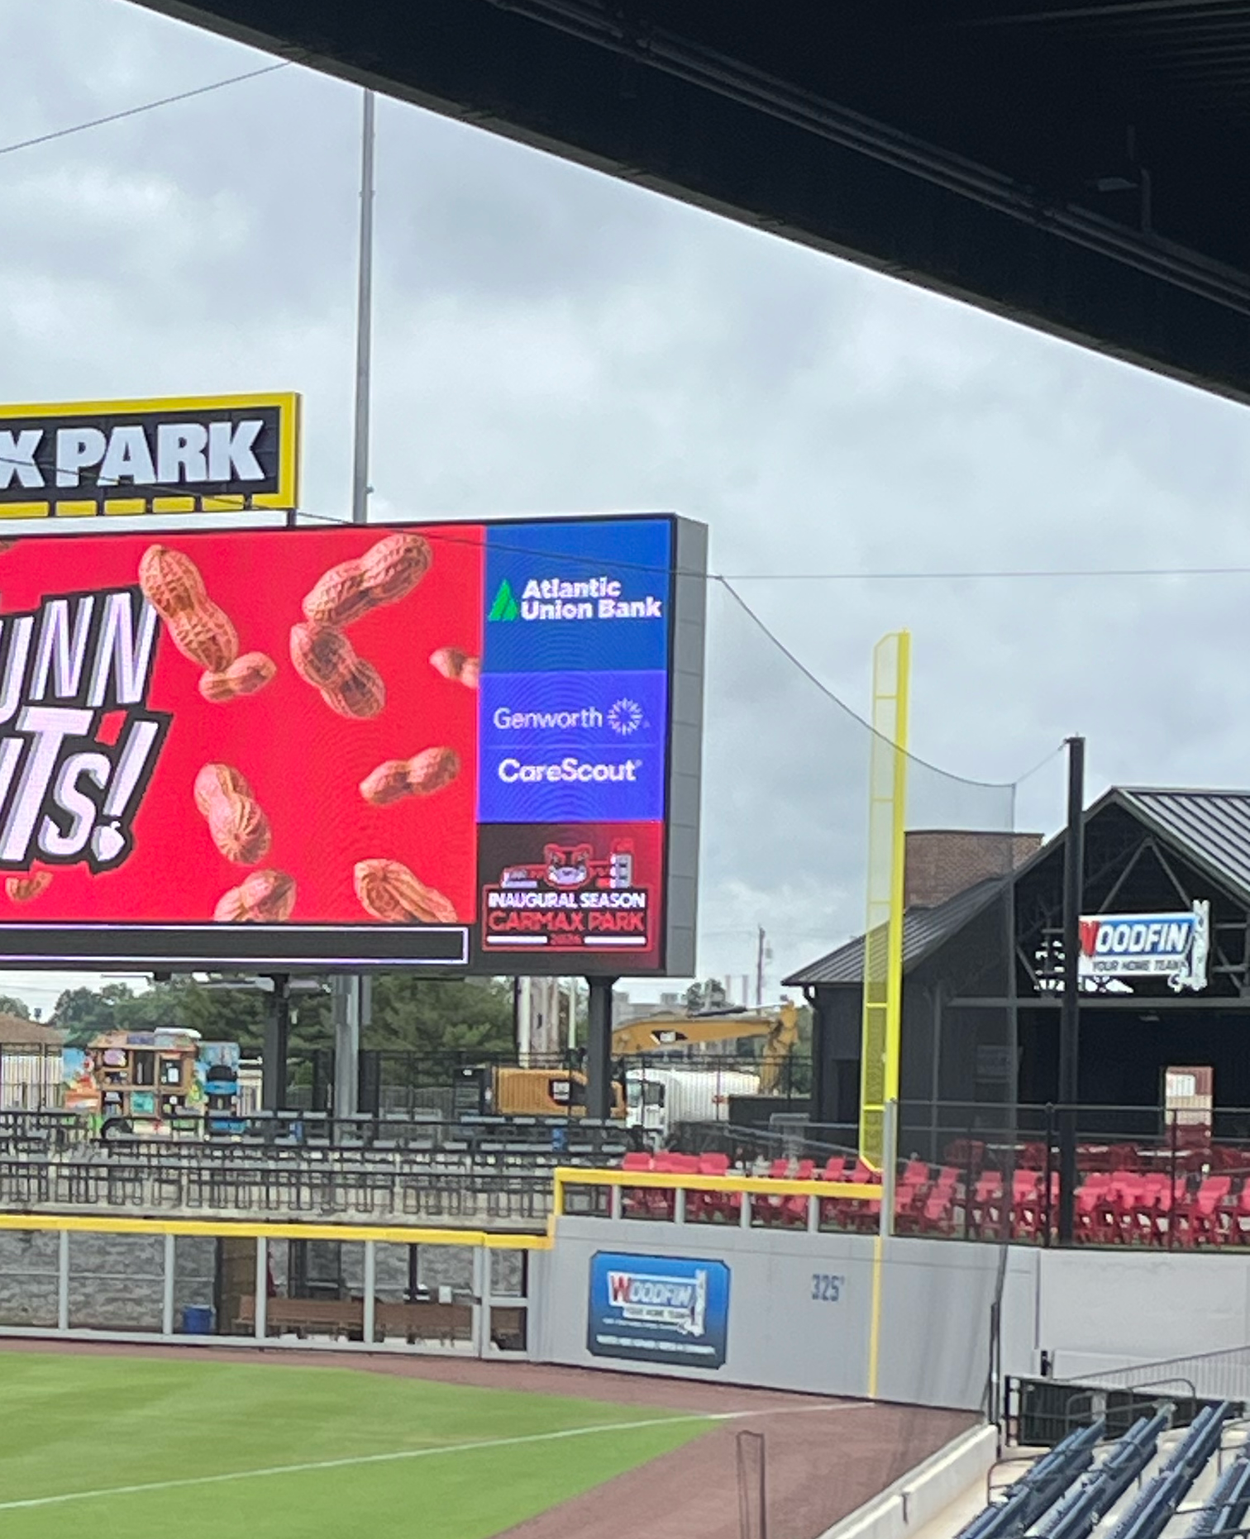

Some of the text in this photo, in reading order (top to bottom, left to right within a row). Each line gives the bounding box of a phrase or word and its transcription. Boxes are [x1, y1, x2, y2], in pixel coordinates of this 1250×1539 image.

[56, 419, 264, 488] PARK
[522, 576, 621, 599] Atlantic
[521, 597, 662, 620] Union Bank
[493, 706, 603, 729] Genworth
[498, 758, 637, 783] CareScout
[488, 892, 646, 908] INAUGURAL SEASON
[489, 911, 645, 931] CARMAX PARK
[611, 1275, 691, 1306] WOODFIN
